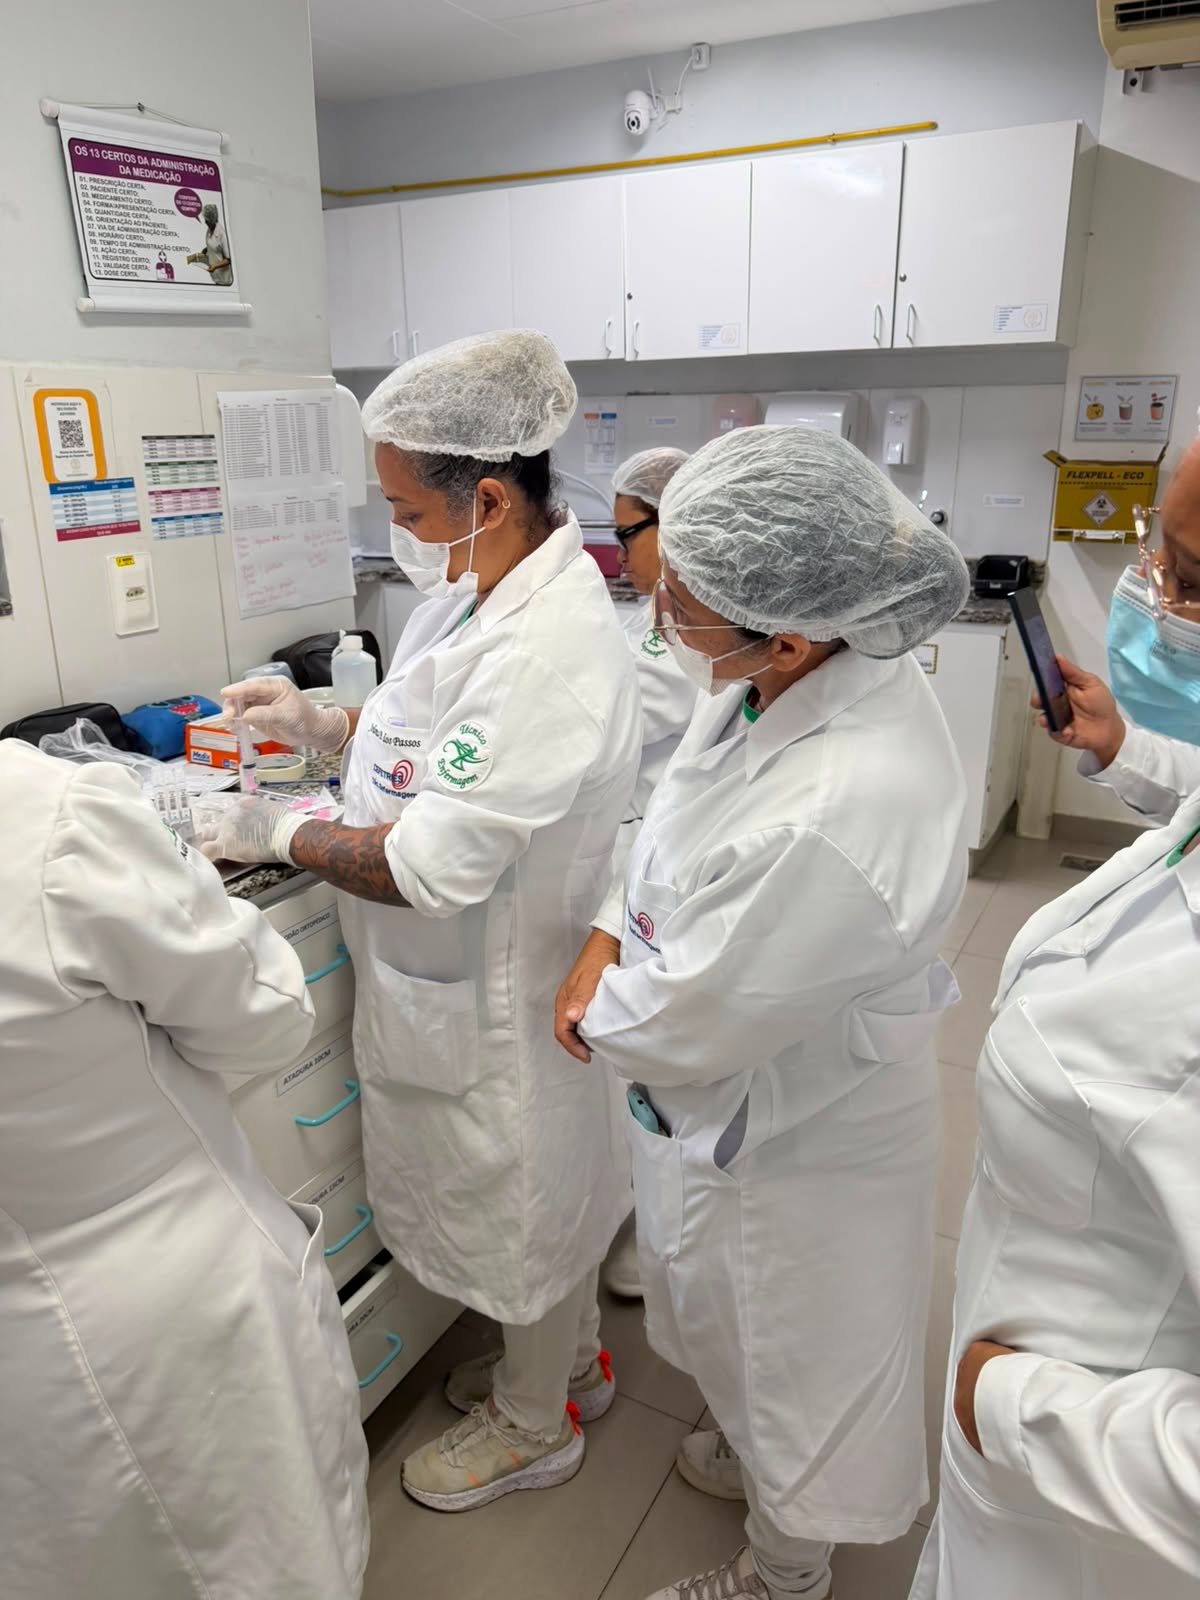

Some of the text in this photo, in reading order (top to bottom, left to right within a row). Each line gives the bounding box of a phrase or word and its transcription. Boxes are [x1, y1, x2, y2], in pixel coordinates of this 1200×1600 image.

[74, 145, 215, 176] OS 13 CERTOS DA ADMINISTRAÇÃO
[119, 165, 181, 182] DA MEDICAÇÃO
[1066, 471, 1115, 479] FLEXPELL
[1123, 471, 1144, 480] ECO
[393, 736, 421, 748] Passos
[459, 724, 487, 746] Técnico
[438, 758, 479, 789] Enfermagem
[284, 1062, 313, 1085] ATADURA
